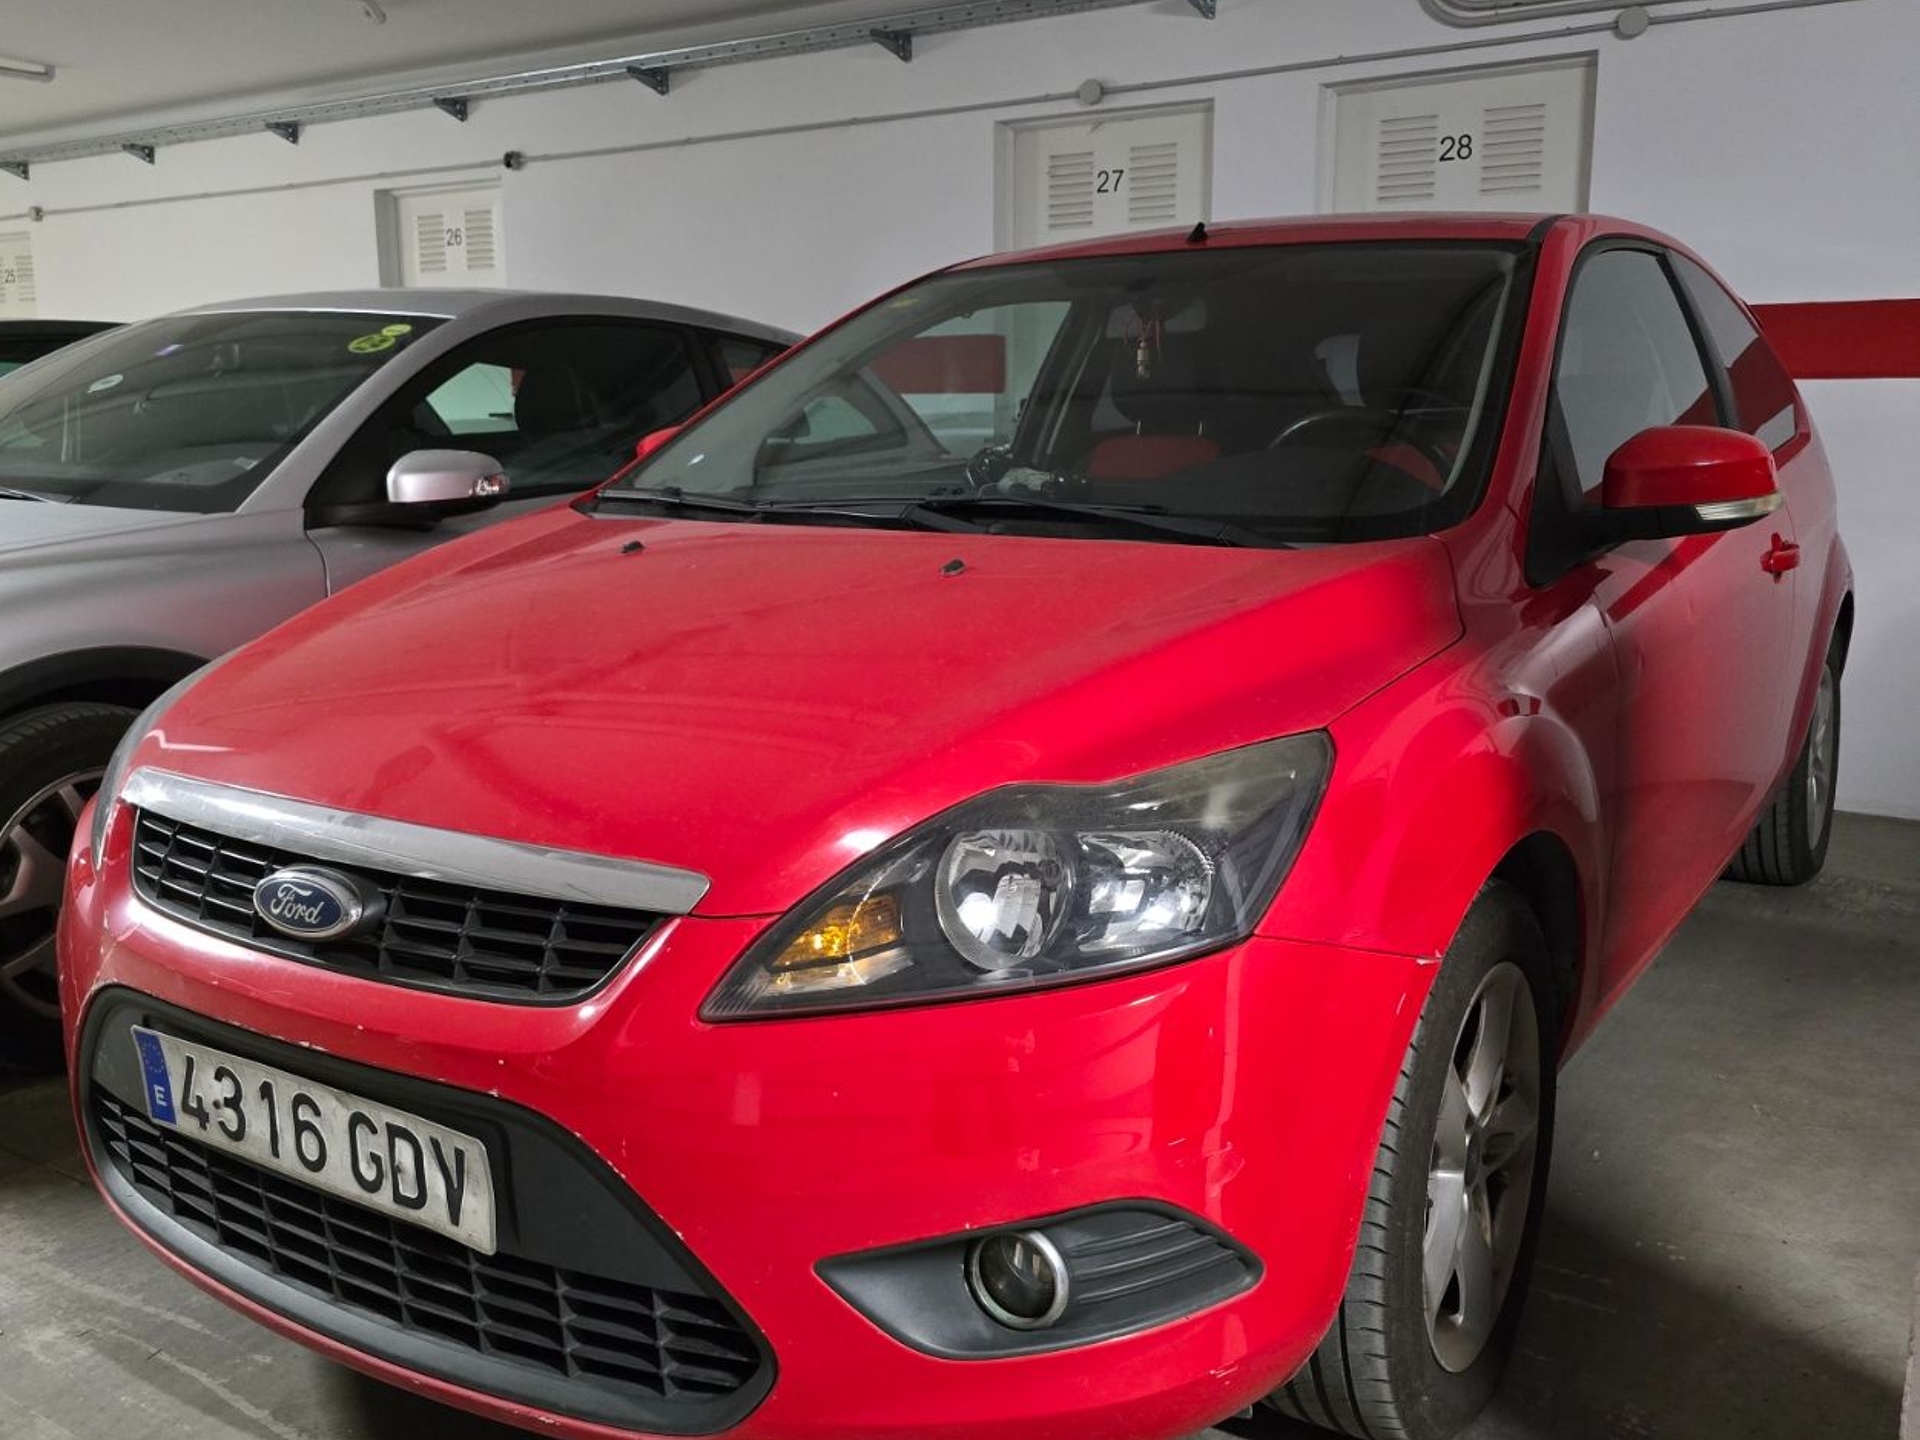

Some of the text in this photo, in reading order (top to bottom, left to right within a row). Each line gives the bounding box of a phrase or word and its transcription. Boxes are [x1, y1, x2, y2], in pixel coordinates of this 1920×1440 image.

[1439, 134, 1472, 162] 28
[1097, 169, 1124, 193] 27
[446, 227, 463, 246] 26
[270, 883, 325, 924] Ford
[154, 1084, 168, 1107] E
[181, 1055, 466, 1227] 4316 GDV
